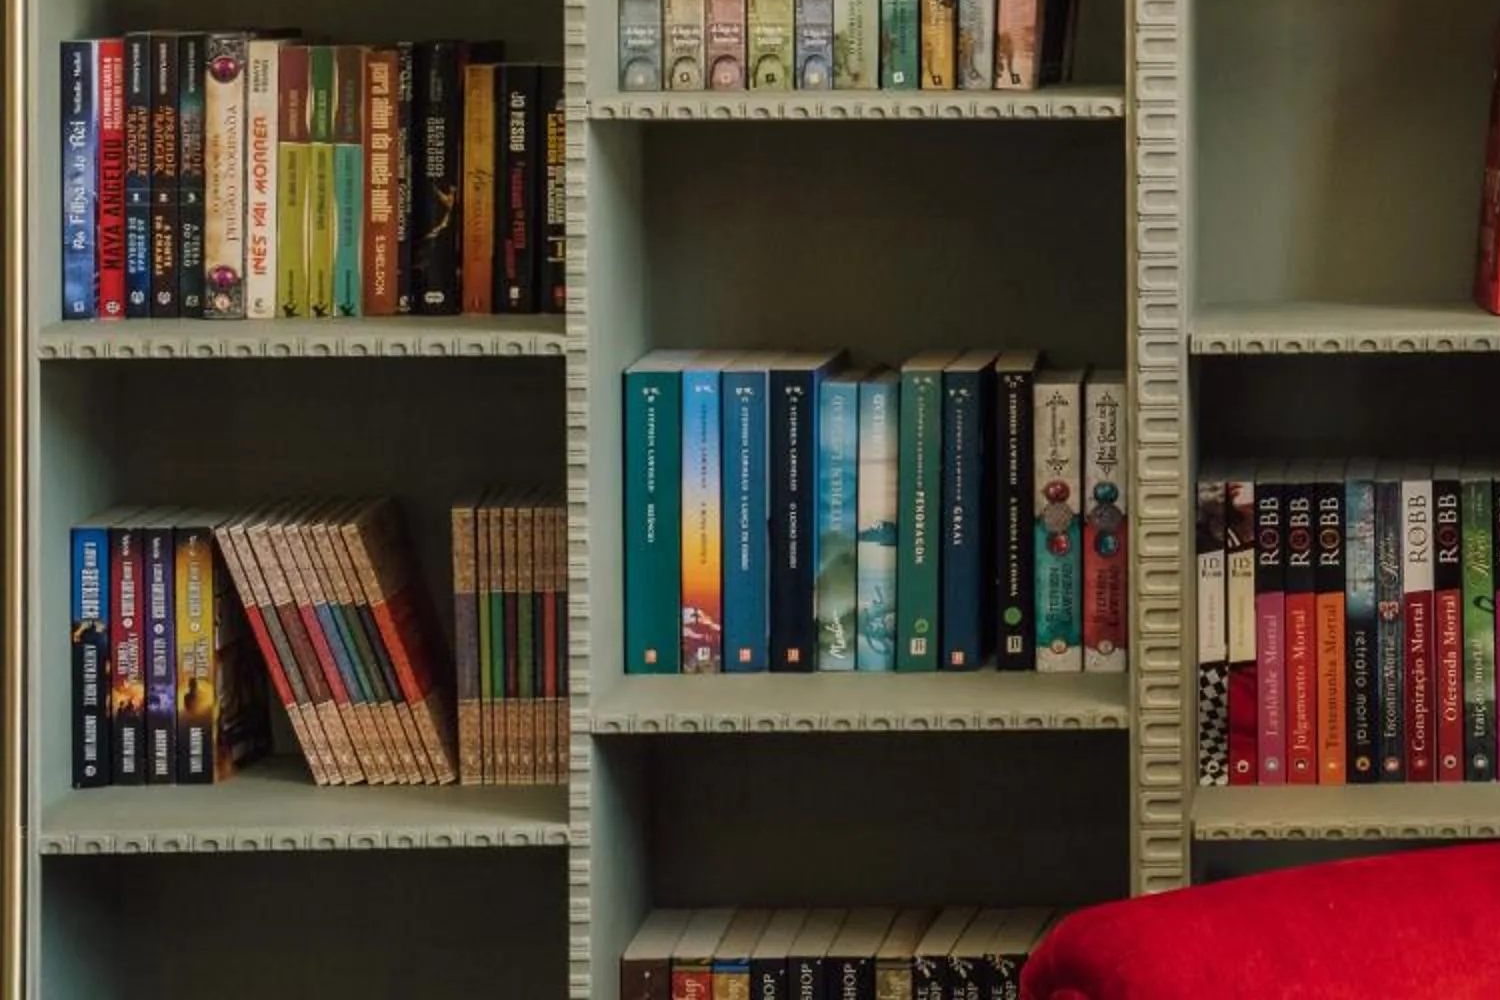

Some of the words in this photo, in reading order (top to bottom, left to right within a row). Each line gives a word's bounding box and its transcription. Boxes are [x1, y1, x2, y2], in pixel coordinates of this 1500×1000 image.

[369, 62, 391, 93] para
[371, 97, 394, 129] além
[371, 133, 393, 149] da
[102, 138, 122, 219] ANGELOU
[370, 152, 394, 223] meia-noite
[102, 225, 122, 270] MAYA
[1260, 497, 1279, 566] ROBB
[1290, 497, 1310, 566] ROBB
[1321, 497, 1339, 565] ROBB
[1409, 494, 1427, 564] ROBB
[1439, 494, 1458, 564] ROBB
[1354, 630, 1369, 687] retrato
[1412, 603, 1425, 653] Mortal
[1355, 693, 1369, 745] mortal
